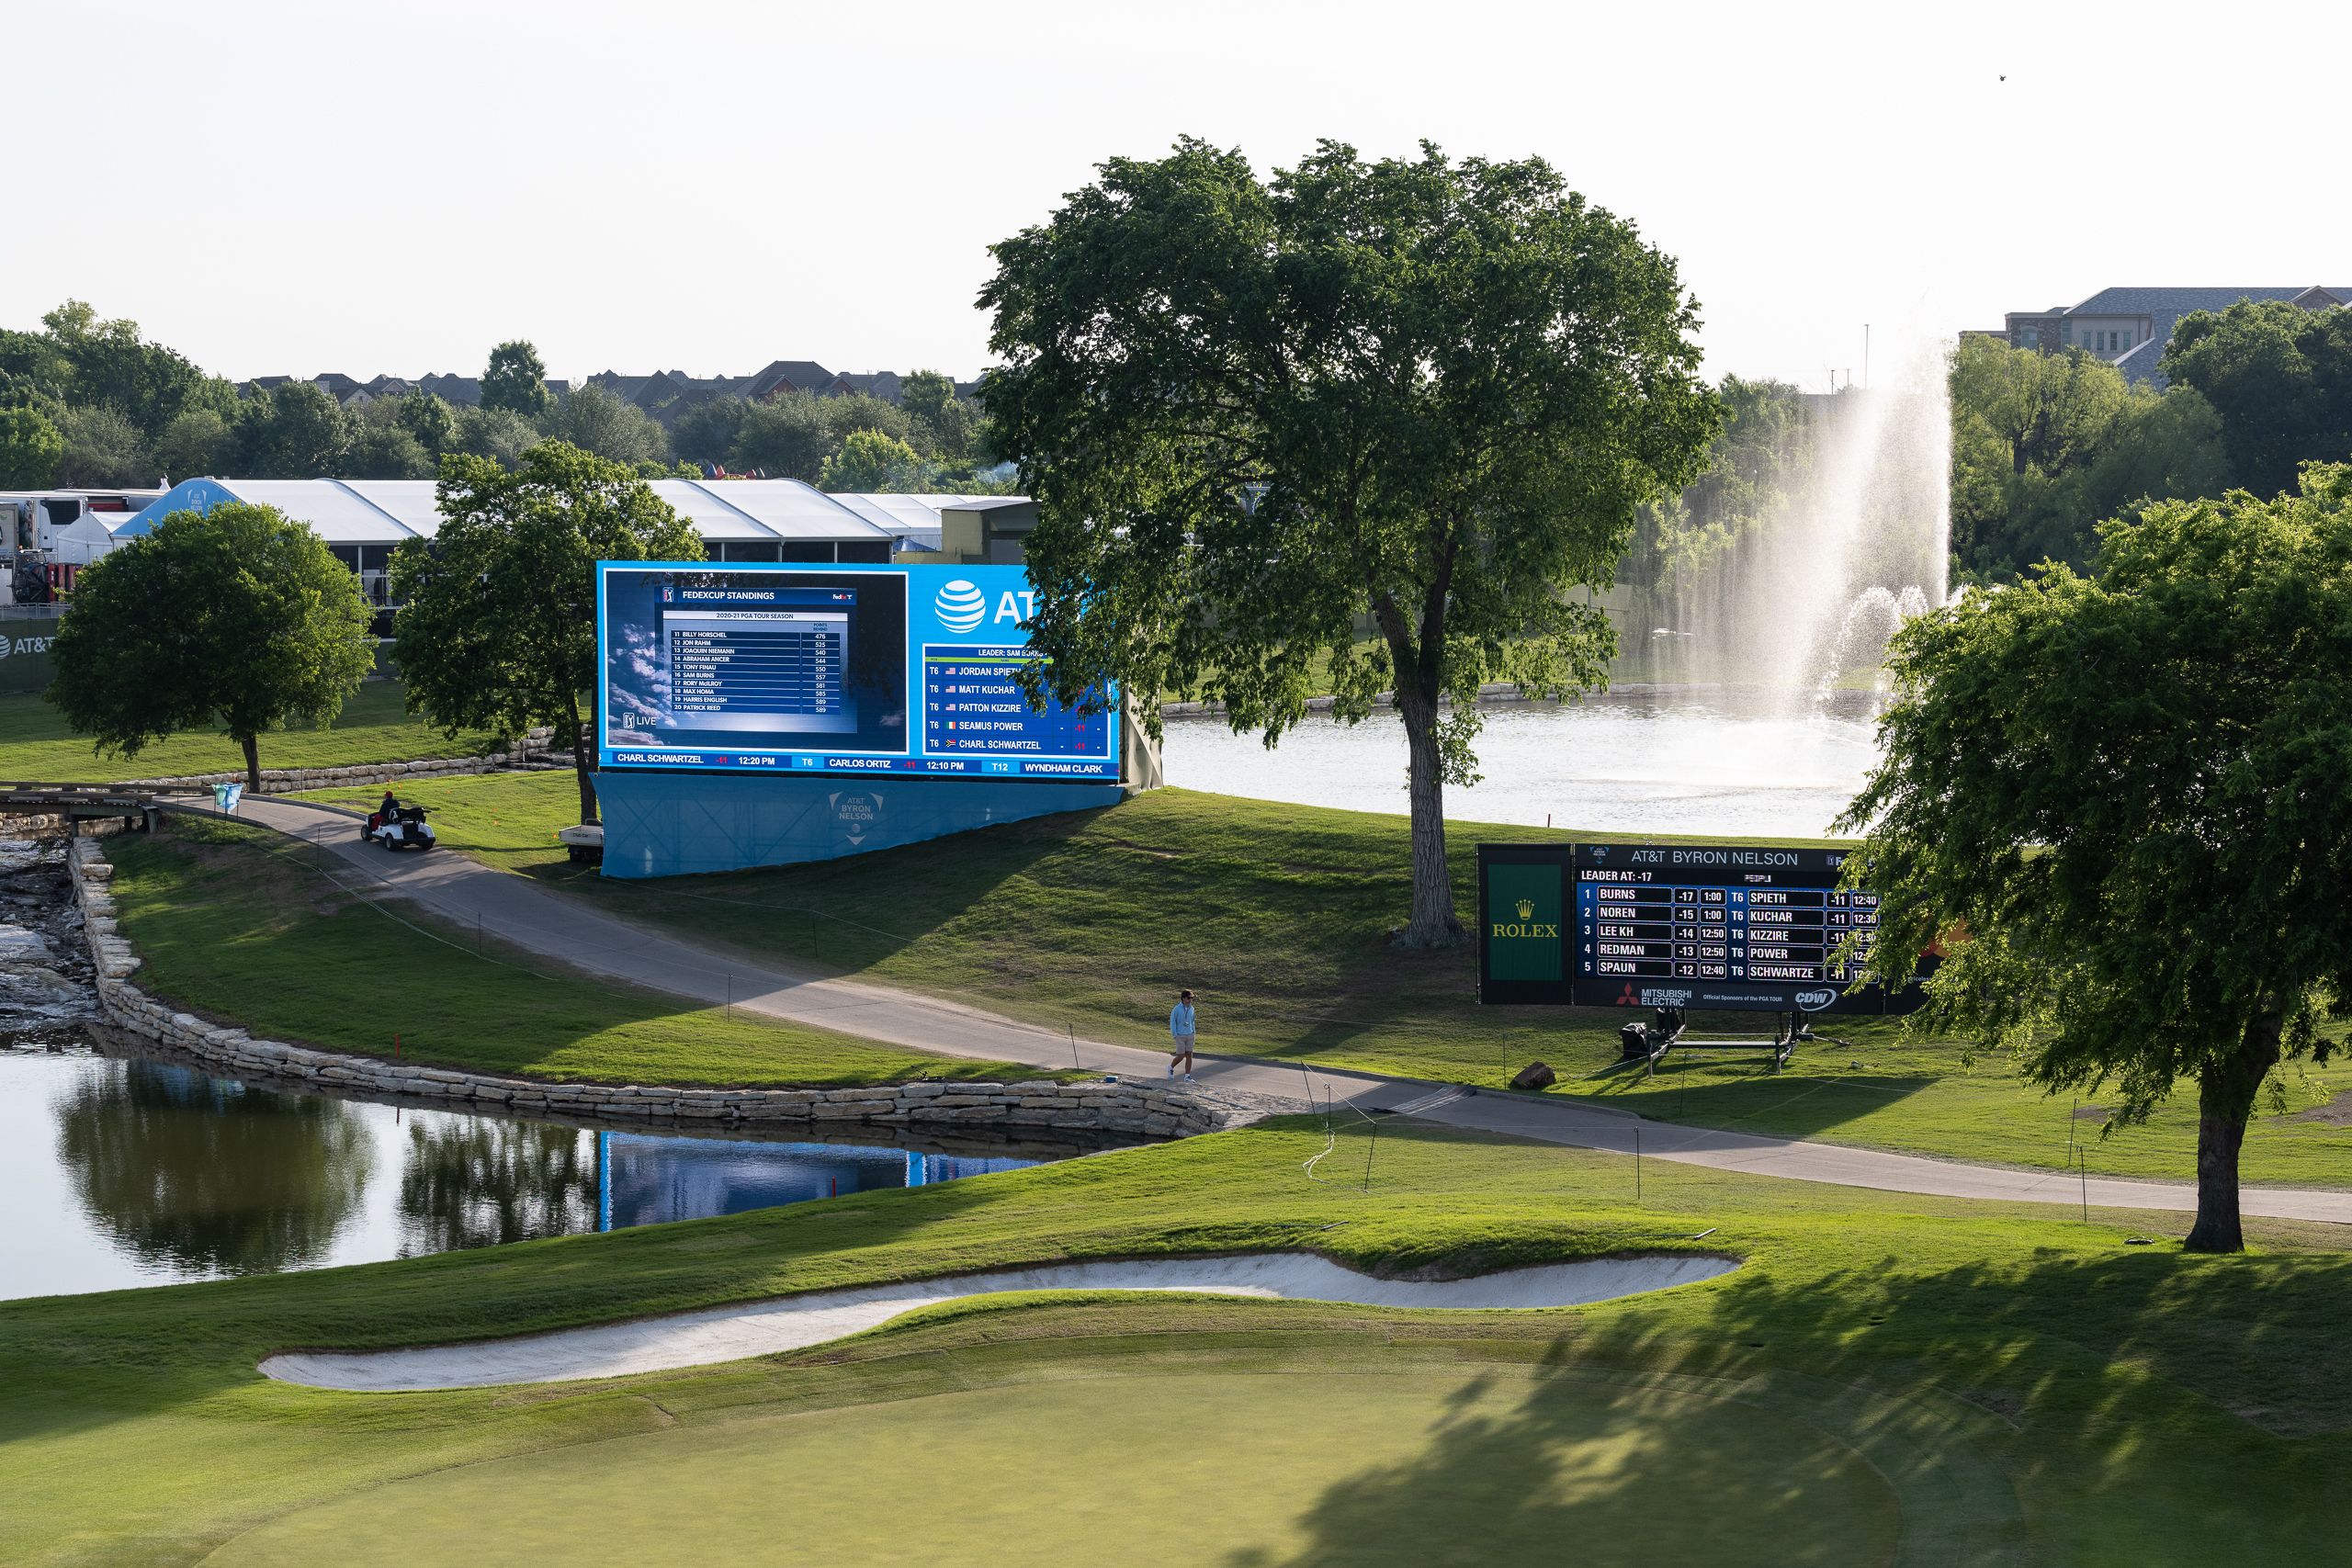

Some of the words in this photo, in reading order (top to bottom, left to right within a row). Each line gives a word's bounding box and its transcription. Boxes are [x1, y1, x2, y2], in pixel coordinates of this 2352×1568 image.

[683, 591, 725, 599] FEDEXCUP
[727, 592, 775, 600] STANDINGS
[930, 667, 939, 675] T6
[958, 667, 991, 676] JORDAN
[930, 685, 939, 694] T6
[959, 685, 979, 694] MATT
[981, 685, 1015, 694] KUCHAR
[930, 703, 939, 711] T6
[959, 703, 989, 712] PATTON
[991, 704, 1022, 713] KIZZIRE
[637, 716, 656, 725] LIVE
[930, 721, 939, 729] T6
[959, 721, 992, 730] SEAMUS
[994, 722, 1023, 731] POWER
[1075, 724, 1085, 732] -11
[959, 739, 986, 749] CHARL
[988, 740, 1041, 750] SCHWARTZEL
[1075, 742, 1085, 750] -11
[617, 753, 646, 761] CHARL
[647, 754, 704, 763] SCHWARTZEL
[739, 756, 760, 764] 12:20
[762, 757, 775, 765] PM
[829, 759, 865, 767] CARLOS
[866, 760, 891, 768] ORTIZ
[926, 761, 948, 770] 12:10
[992, 763, 1008, 772] T12
[1025, 764, 1071, 773] WYNDHAM
[1072, 764, 1102, 773] CLARK
[842, 805, 871, 813] BYRON
[1632, 851, 1665, 863] AT&T
[1673, 852, 1727, 863] BYRON
[1733, 852, 1798, 865] NELSON
[1581, 871, 1618, 880] LEADER
[1620, 872, 1635, 881] AT:
[1637, 872, 1652, 882] -17
[1585, 889, 1590, 898] 1
[1600, 889, 1635, 899] BURNS
[1679, 892, 1693, 901] -17
[1704, 892, 1721, 901] 1:00
[1732, 893, 1743, 902] T6
[1750, 893, 1787, 904] SPIETH
[1830, 896, 1845, 905] -11
[1854, 896, 1876, 905] 12:40
[1585, 908, 1590, 917] 2
[1600, 908, 1635, 918] NOREN
[1679, 909, 1693, 919] -15
[1704, 909, 1721, 919] 1:00
[1732, 911, 1743, 920] T6
[1750, 911, 1792, 922] KUCHAR
[1830, 914, 1845, 923] -11
[1854, 914, 1876, 923] 12:30
[1492, 924, 1558, 937] ROLEX
[1585, 925, 1590, 934] 3
[1600, 926, 1617, 936] LEE
[1619, 926, 1634, 937] KH
[1679, 929, 1693, 938] -14
[1702, 929, 1724, 938] 12:50
[1732, 930, 1743, 939] T6
[1750, 931, 1789, 941] KIZZIRE
[1830, 932, 1844, 942] -11
[1585, 944, 1590, 953] 4
[1600, 944, 1645, 955] REDMAN
[1679, 947, 1693, 956] -13
[1702, 947, 1724, 956] 12:50
[1732, 948, 1743, 957] T6
[1750, 948, 1788, 959] POWER
[1585, 962, 1590, 971] 5
[1600, 963, 1635, 973] SPAUN
[1679, 965, 1693, 975] -12
[1702, 965, 1724, 975] 12:40
[1732, 966, 1743, 976] T6
[1750, 967, 1814, 978] SCHWARTZE
[1641, 988, 1692, 998] MITSUBISHI
[1795, 992, 1828, 1004] CDW
[1641, 997, 1685, 1006] ELECTRIC
